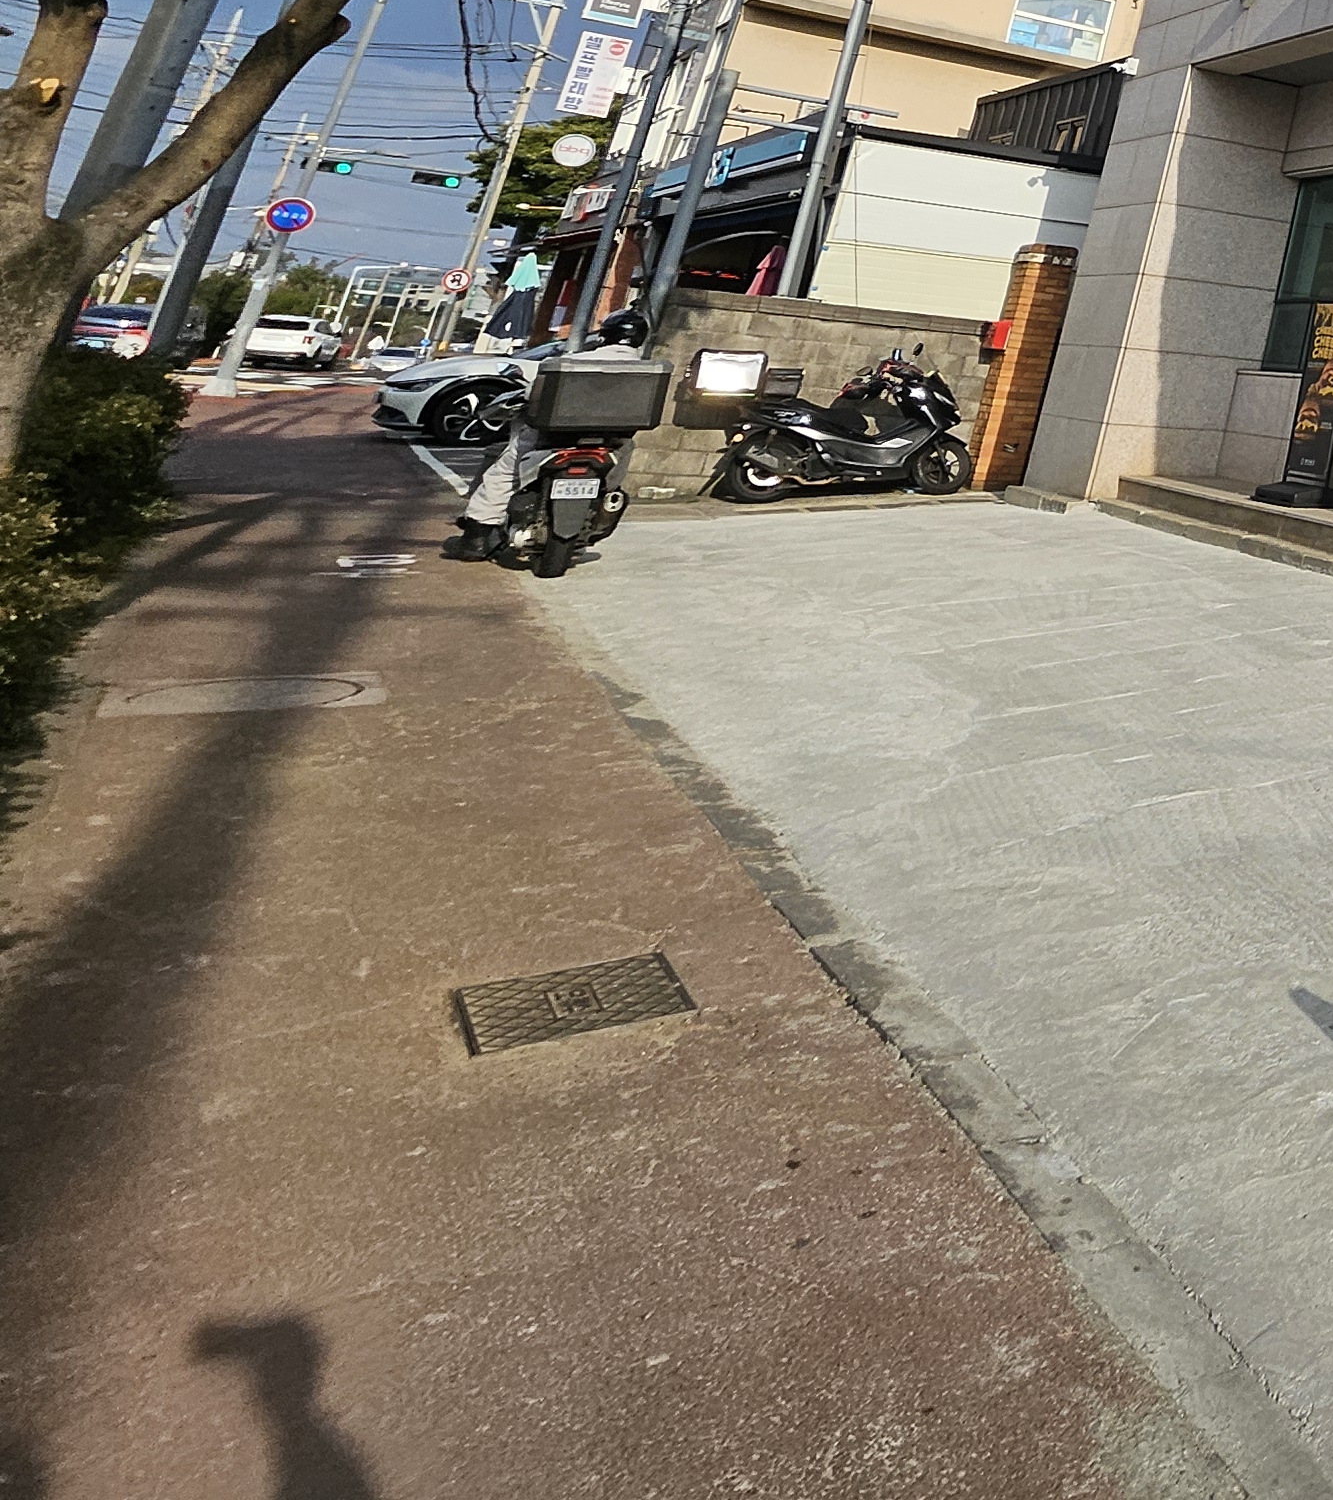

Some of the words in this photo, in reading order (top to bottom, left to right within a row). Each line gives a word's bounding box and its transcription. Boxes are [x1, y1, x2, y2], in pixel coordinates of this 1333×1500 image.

[563, 35, 603, 111] 셀프빨래방
[559, 143, 590, 157] bbq
[564, 486, 594, 496] 5514
